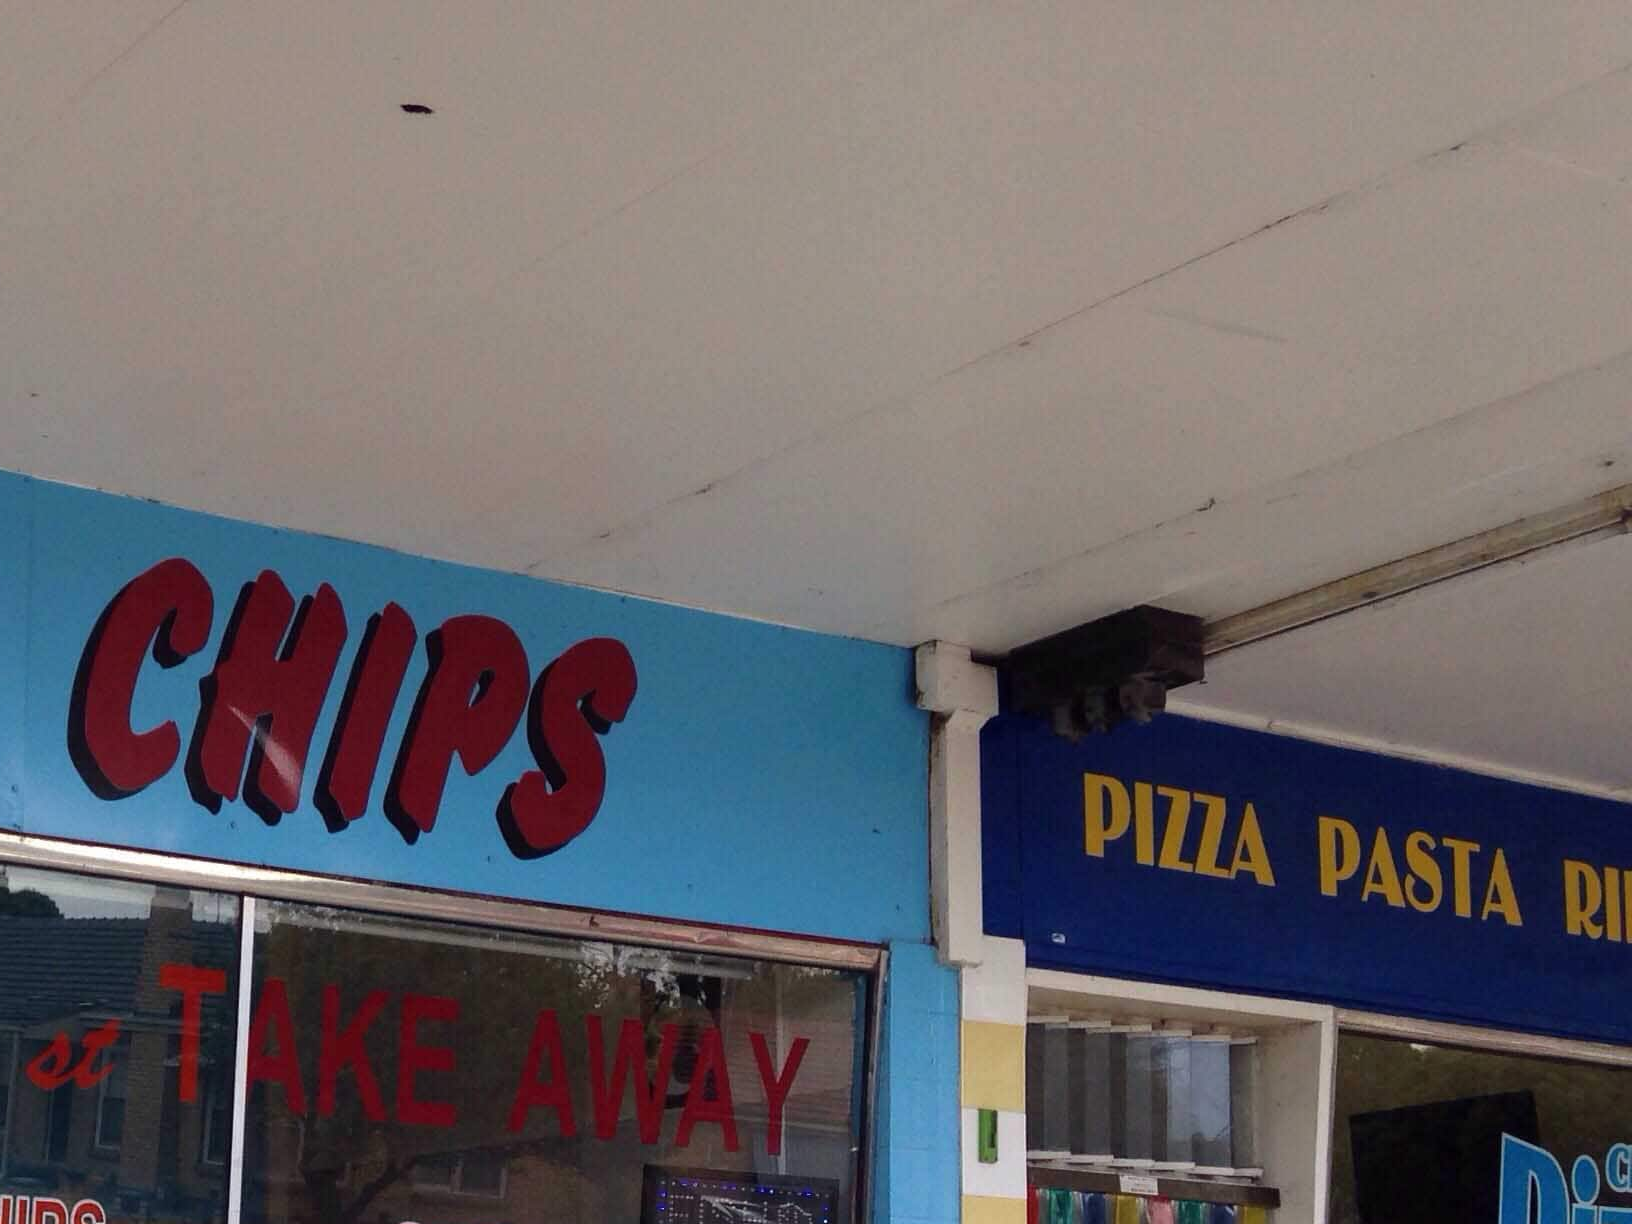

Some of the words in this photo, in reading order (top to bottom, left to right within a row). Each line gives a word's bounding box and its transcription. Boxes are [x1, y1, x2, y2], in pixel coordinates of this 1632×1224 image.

[67, 558, 637, 860] CHIPS
[1083, 773, 1275, 887] PIZZA
[1318, 816, 1523, 926] PASTA
[25, 1018, 125, 1089] st
[160, 963, 461, 1128] TAKE
[506, 1010, 811, 1156] AWAY
